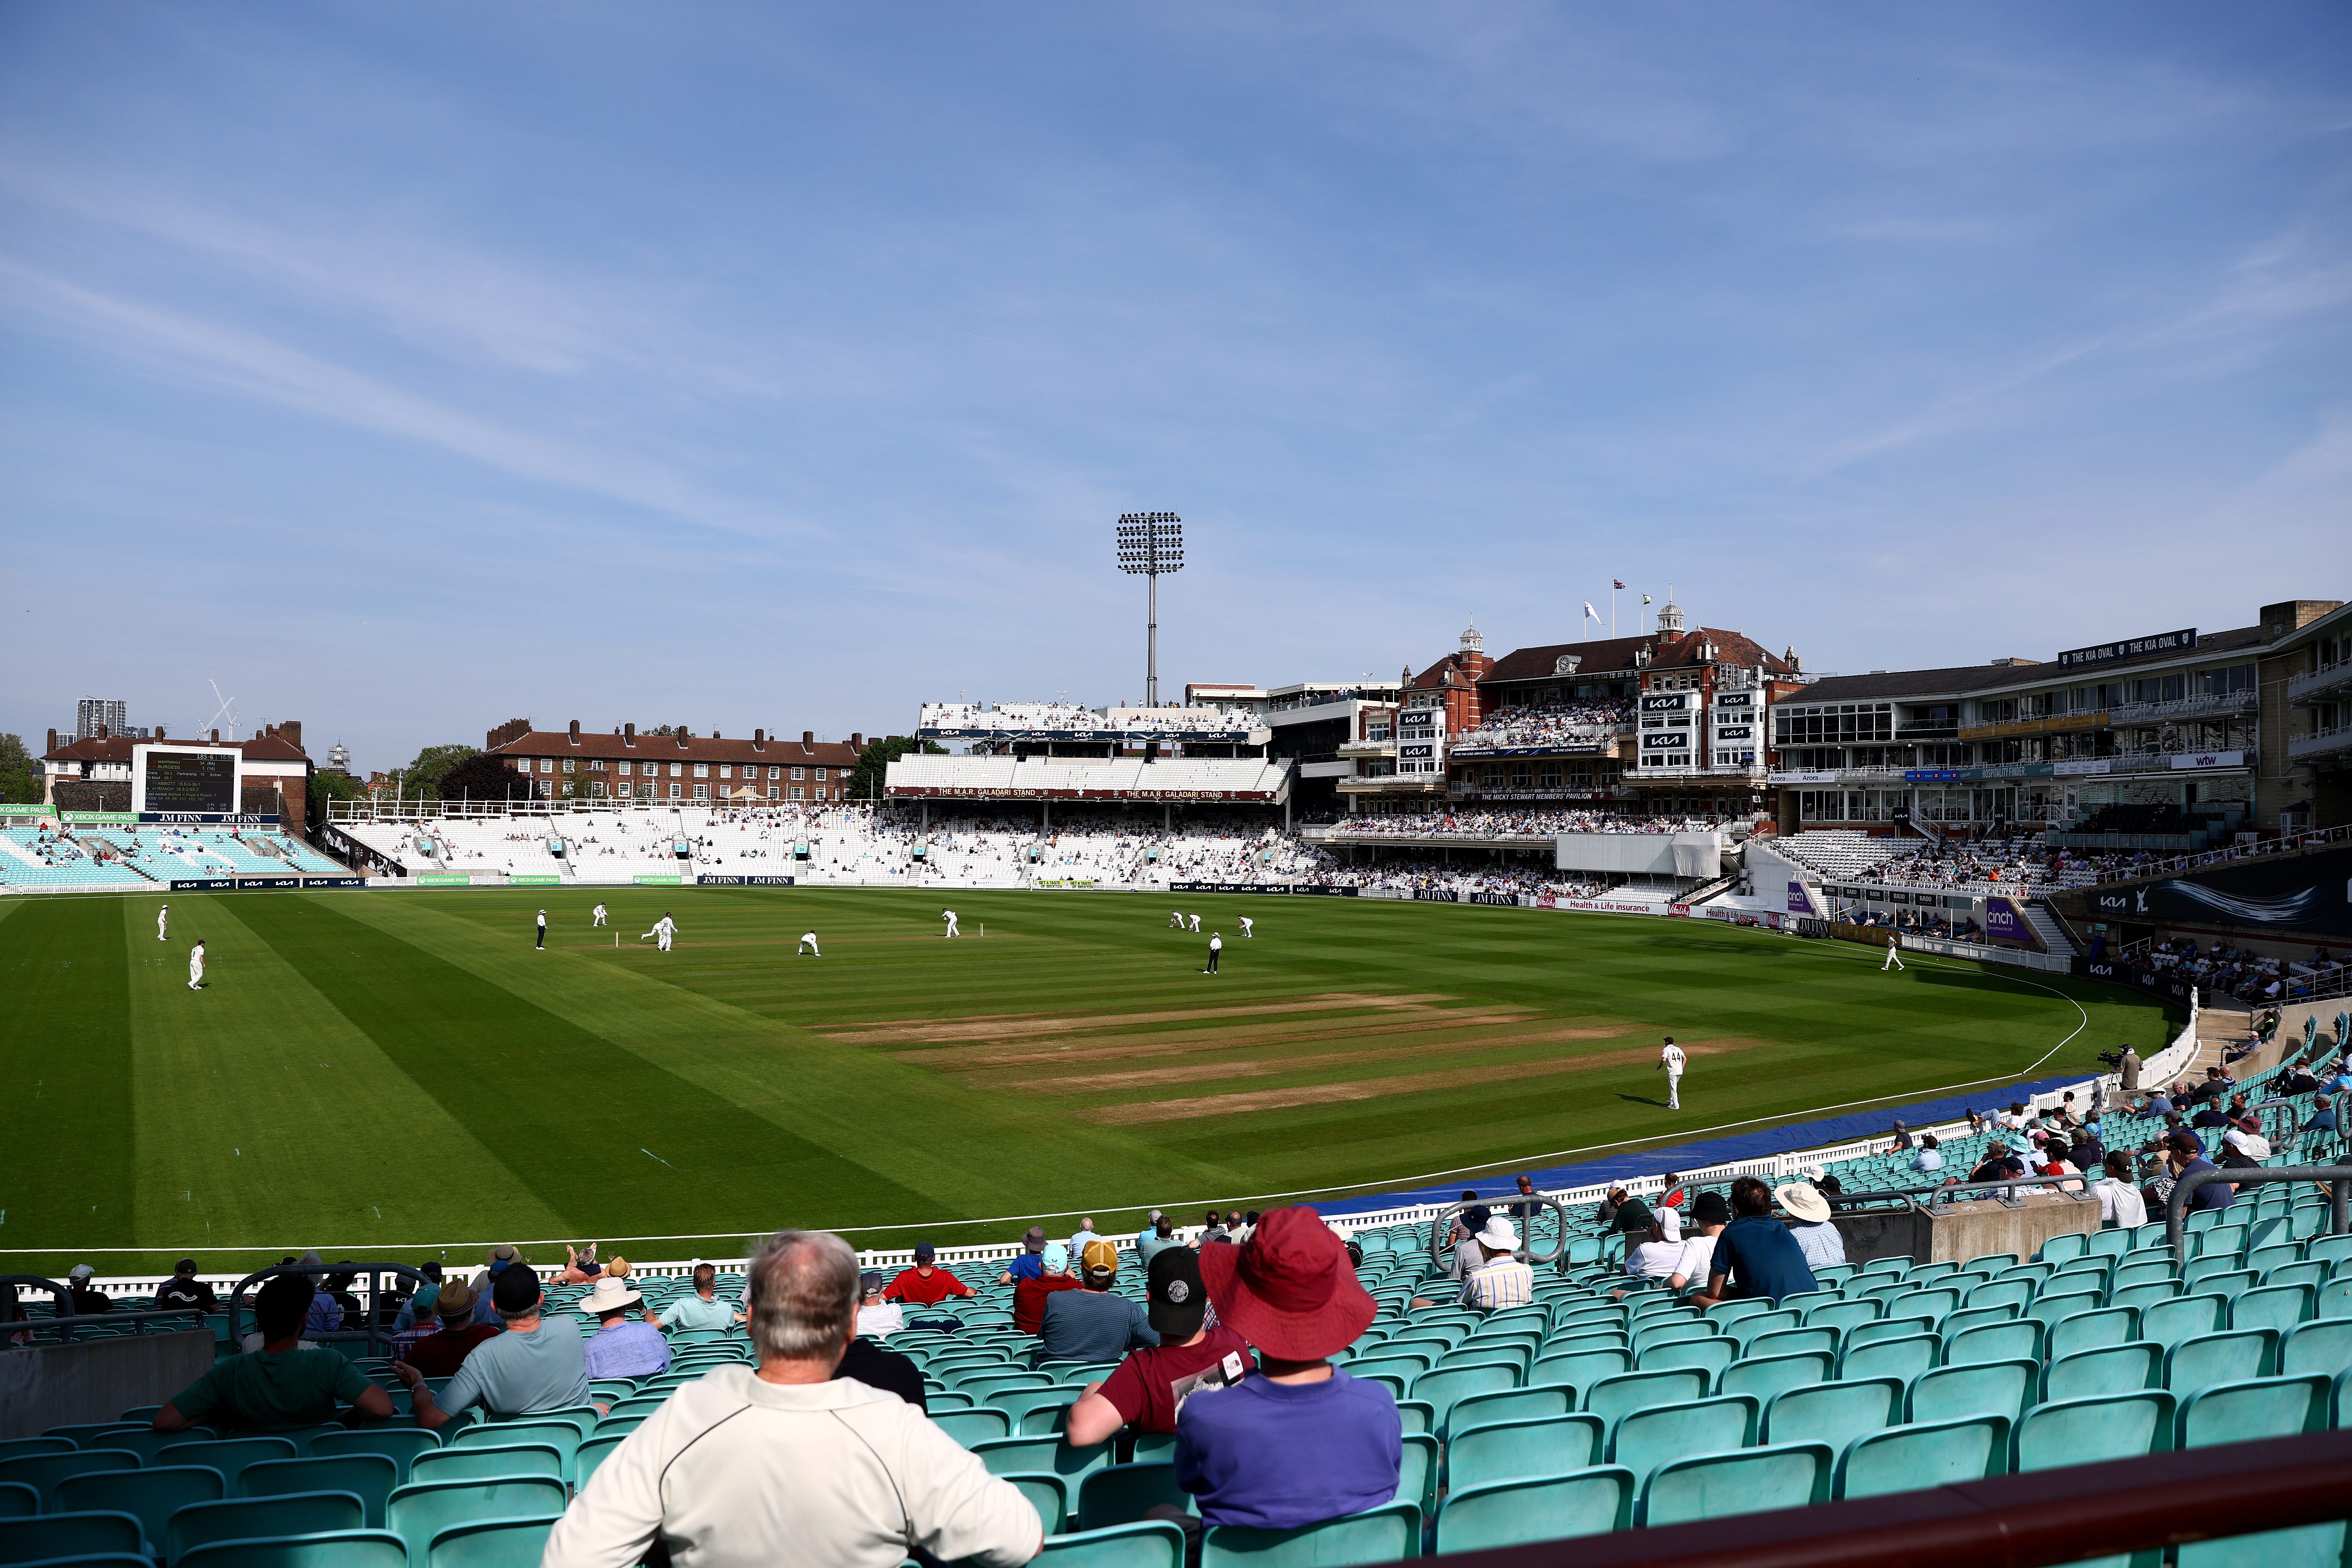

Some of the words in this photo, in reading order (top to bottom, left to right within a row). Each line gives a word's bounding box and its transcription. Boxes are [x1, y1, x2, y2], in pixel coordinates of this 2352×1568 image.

[2129, 641, 2142, 653] THE
[2145, 639, 2156, 651] KIA
[2159, 635, 2177, 648] OVAL
[2072, 652, 2083, 663] THE
[2085, 650, 2096, 661] KIA
[2098, 647, 2114, 659] OVAL
[1650, 698, 1677, 708] KIA
[1405, 715, 1426, 723] KIA
[1651, 736, 1679, 745] KIA
[2196, 755, 2216, 766] wtw
[1982, 766, 2007, 778] HOSPITALITY
[2008, 765, 2027, 776] FINDER.
[1419, 891, 1430, 900] JM
[1432, 891, 1452, 901] FINN
[1476, 894, 1488, 903] JM
[1490, 895, 1512, 904] FINN
[1788, 888, 1803, 902] cinch
[1537, 897, 1555, 908] Vitality
[1570, 900, 1593, 909] Health
[1616, 903, 1650, 912] insurance
[2100, 896, 2126, 907] KIA
[1668, 905, 1690, 917] Vitality
[1706, 909, 1725, 918] Health
[1988, 907, 2013, 925] cinch
[1767, 914, 1779, 928] Vitality
[1800, 918, 1811, 931] JM
[1811, 920, 1828, 933] FINN
[2090, 964, 2112, 975] KIA
[1672, 1052, 1681, 1062] 44
